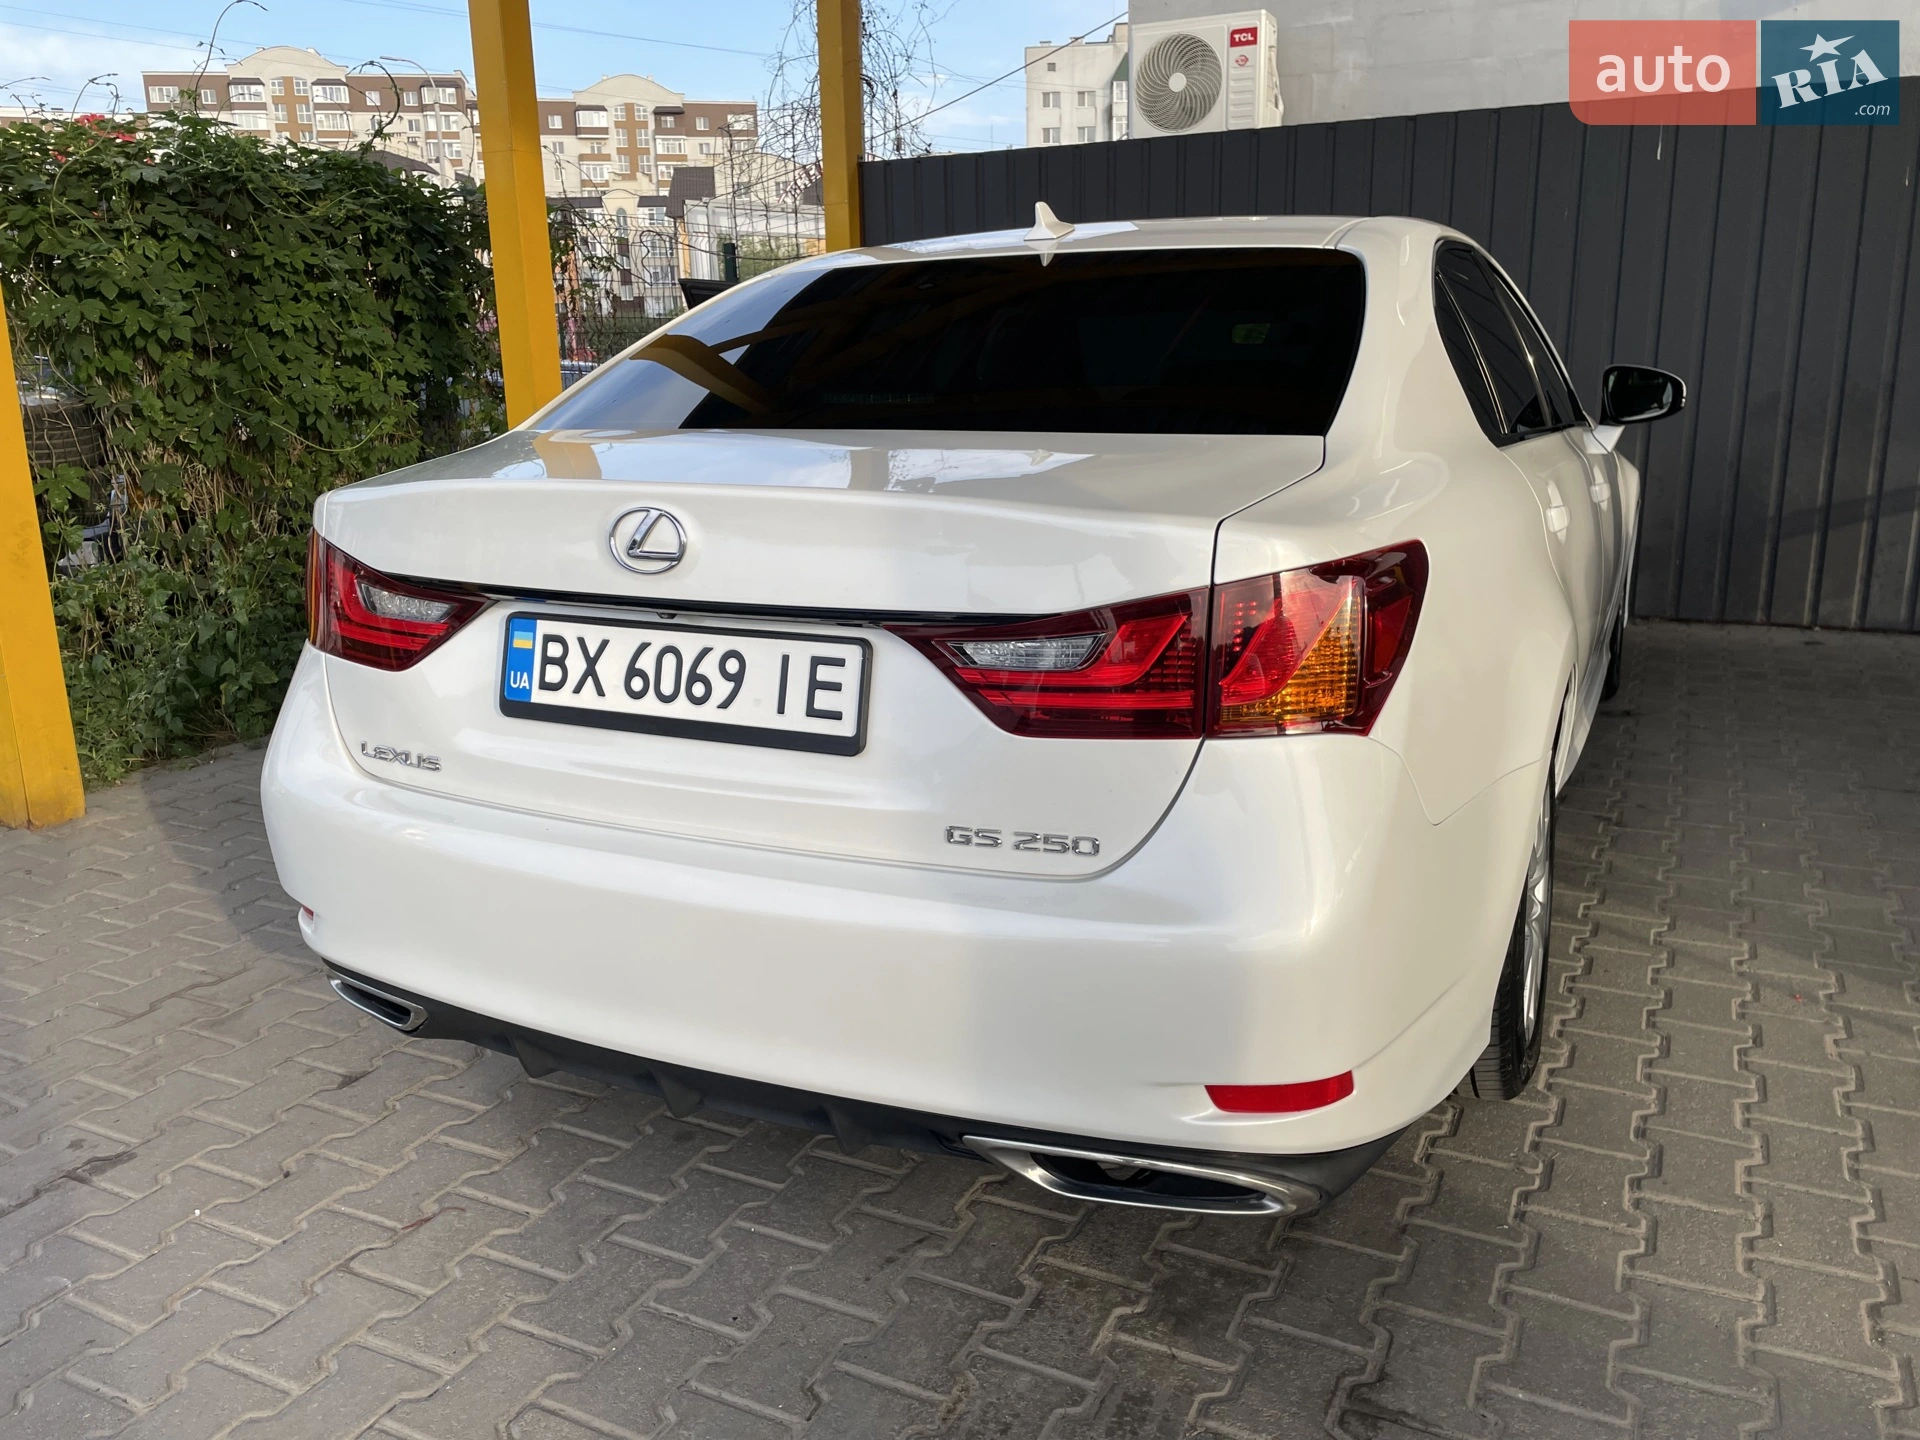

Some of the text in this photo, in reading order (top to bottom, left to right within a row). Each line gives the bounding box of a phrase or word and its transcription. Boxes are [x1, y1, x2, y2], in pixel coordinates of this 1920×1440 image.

[1233, 32, 1255, 43] TCL
[510, 670, 530, 690] UA
[538, 633, 846, 721] BX 6069 IE
[360, 740, 443, 772] LEXUS
[945, 825, 1100, 856] GS 250
